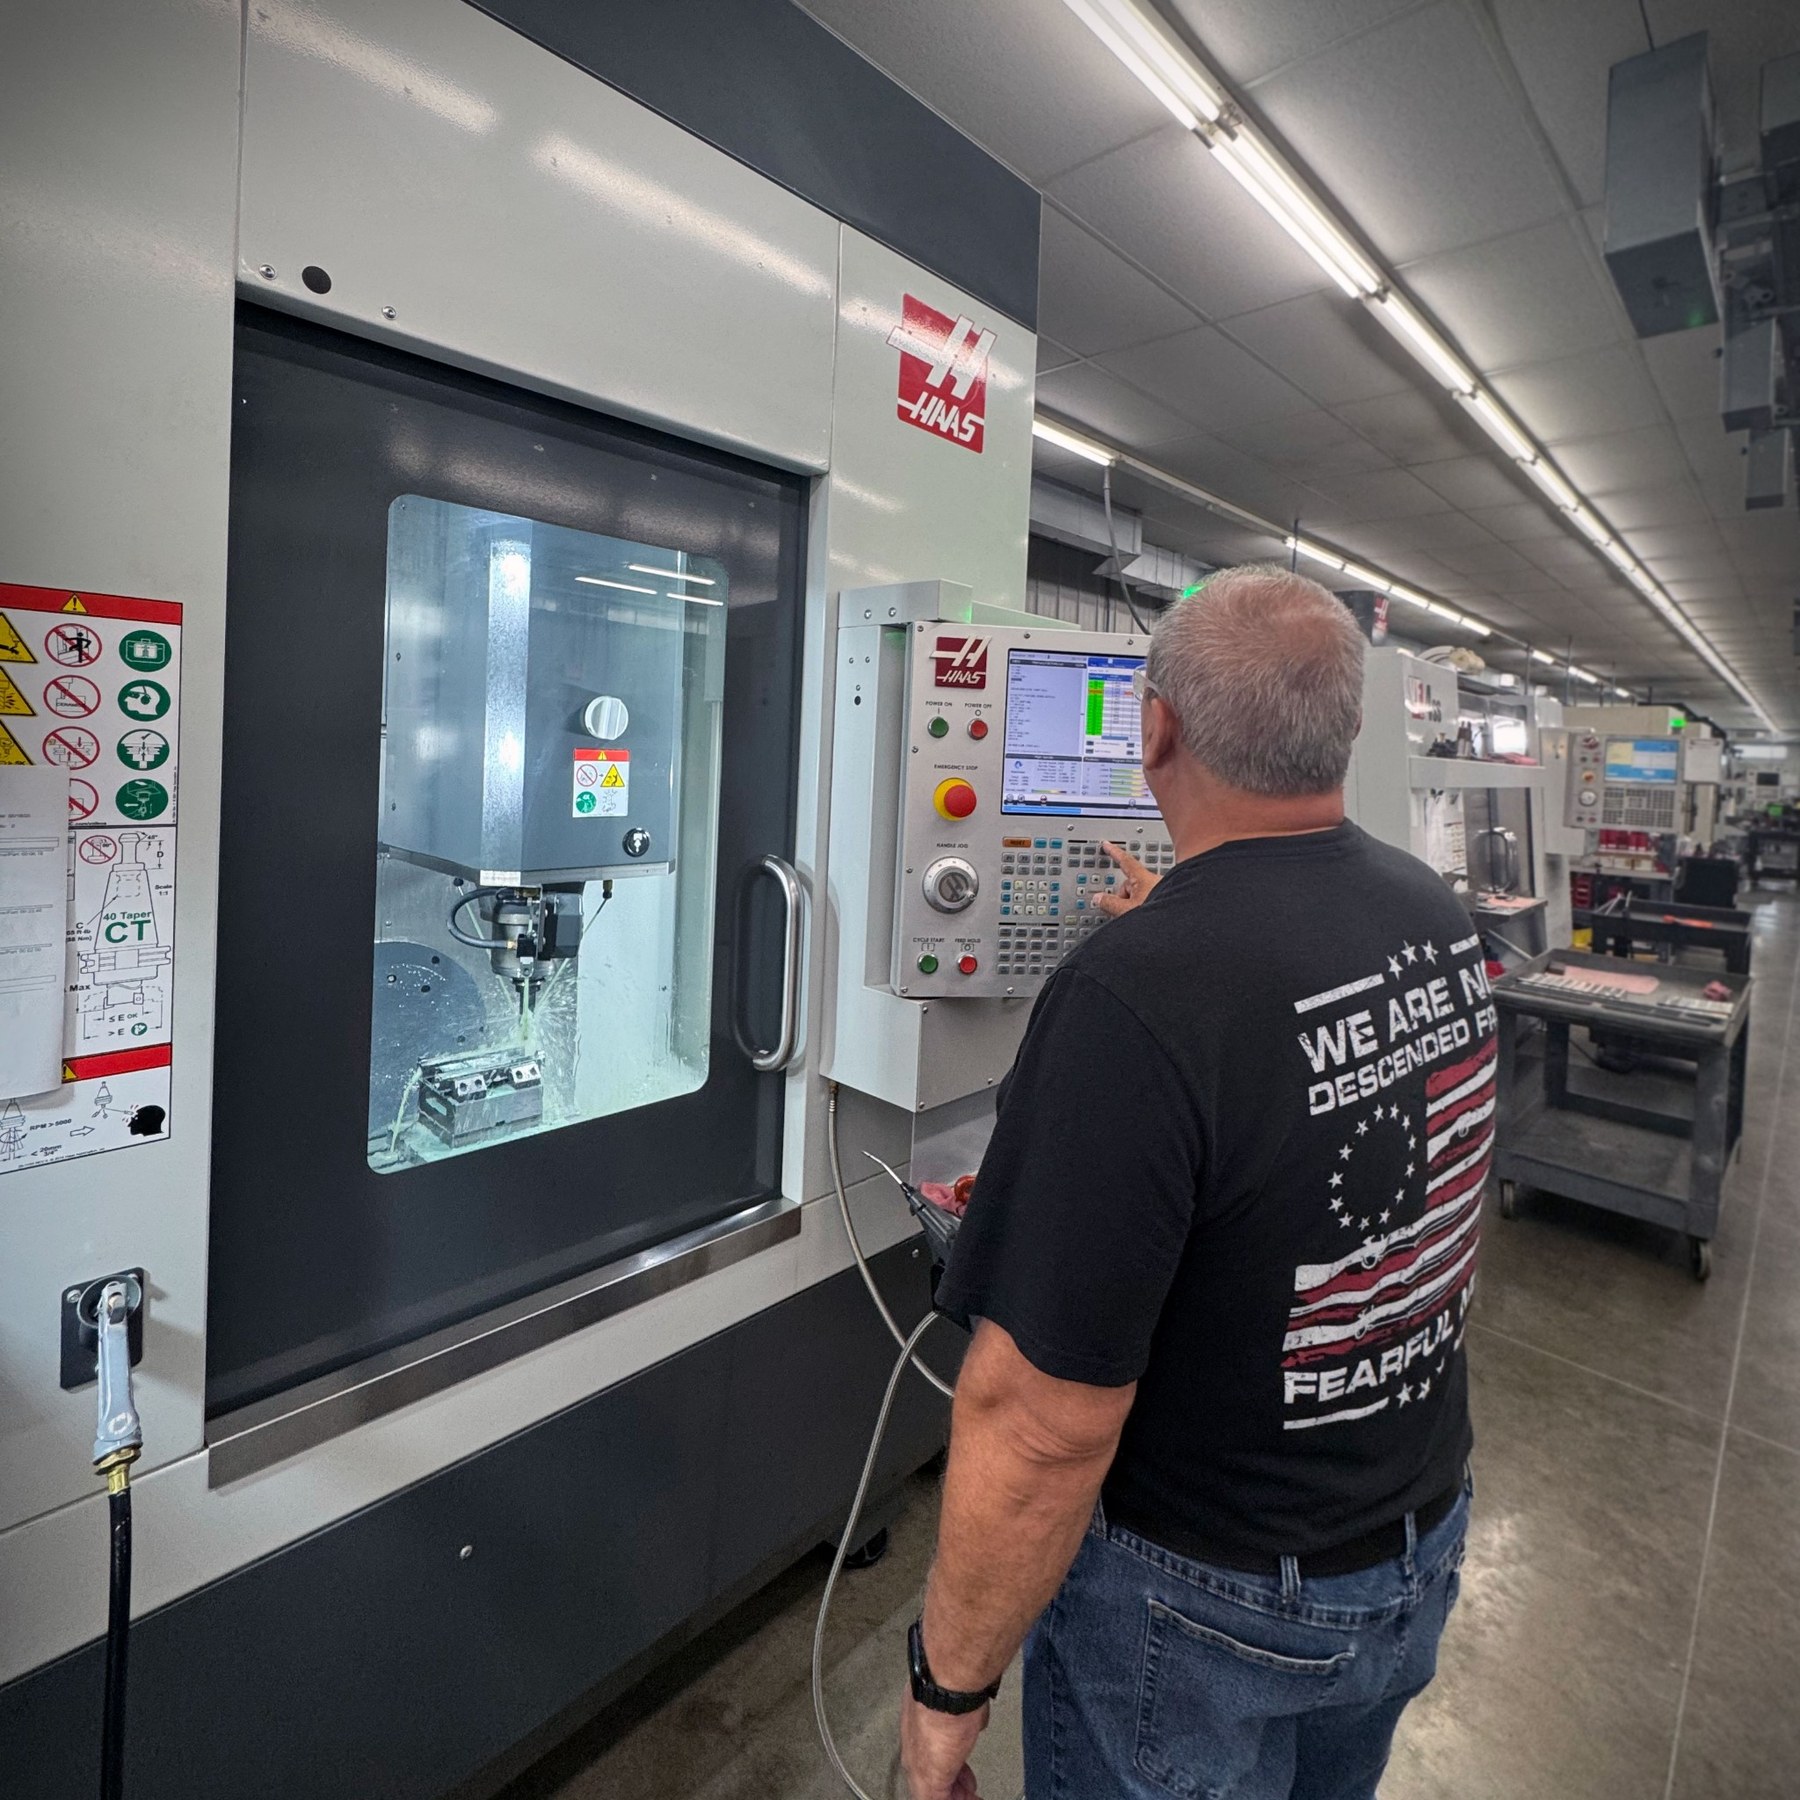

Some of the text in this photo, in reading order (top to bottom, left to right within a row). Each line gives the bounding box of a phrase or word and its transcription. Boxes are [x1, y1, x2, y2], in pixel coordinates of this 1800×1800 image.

[897, 391, 985, 443] HAAS
[936, 670, 986, 684] HAAS
[103, 911, 152, 921] 40 Taper
[105, 920, 152, 943] CT
[69, 984, 91, 992] Max
[118, 1028, 125, 1036] E
[1298, 1009, 1379, 1074] WE
[1388, 976, 1455, 1043] ARE
[1308, 1017, 1471, 1116] DESCENDED
[29, 1123, 47, 1131] RPM
[55, 1118, 72, 1127] 5000
[1284, 1309, 1454, 1404] FEARFUL
